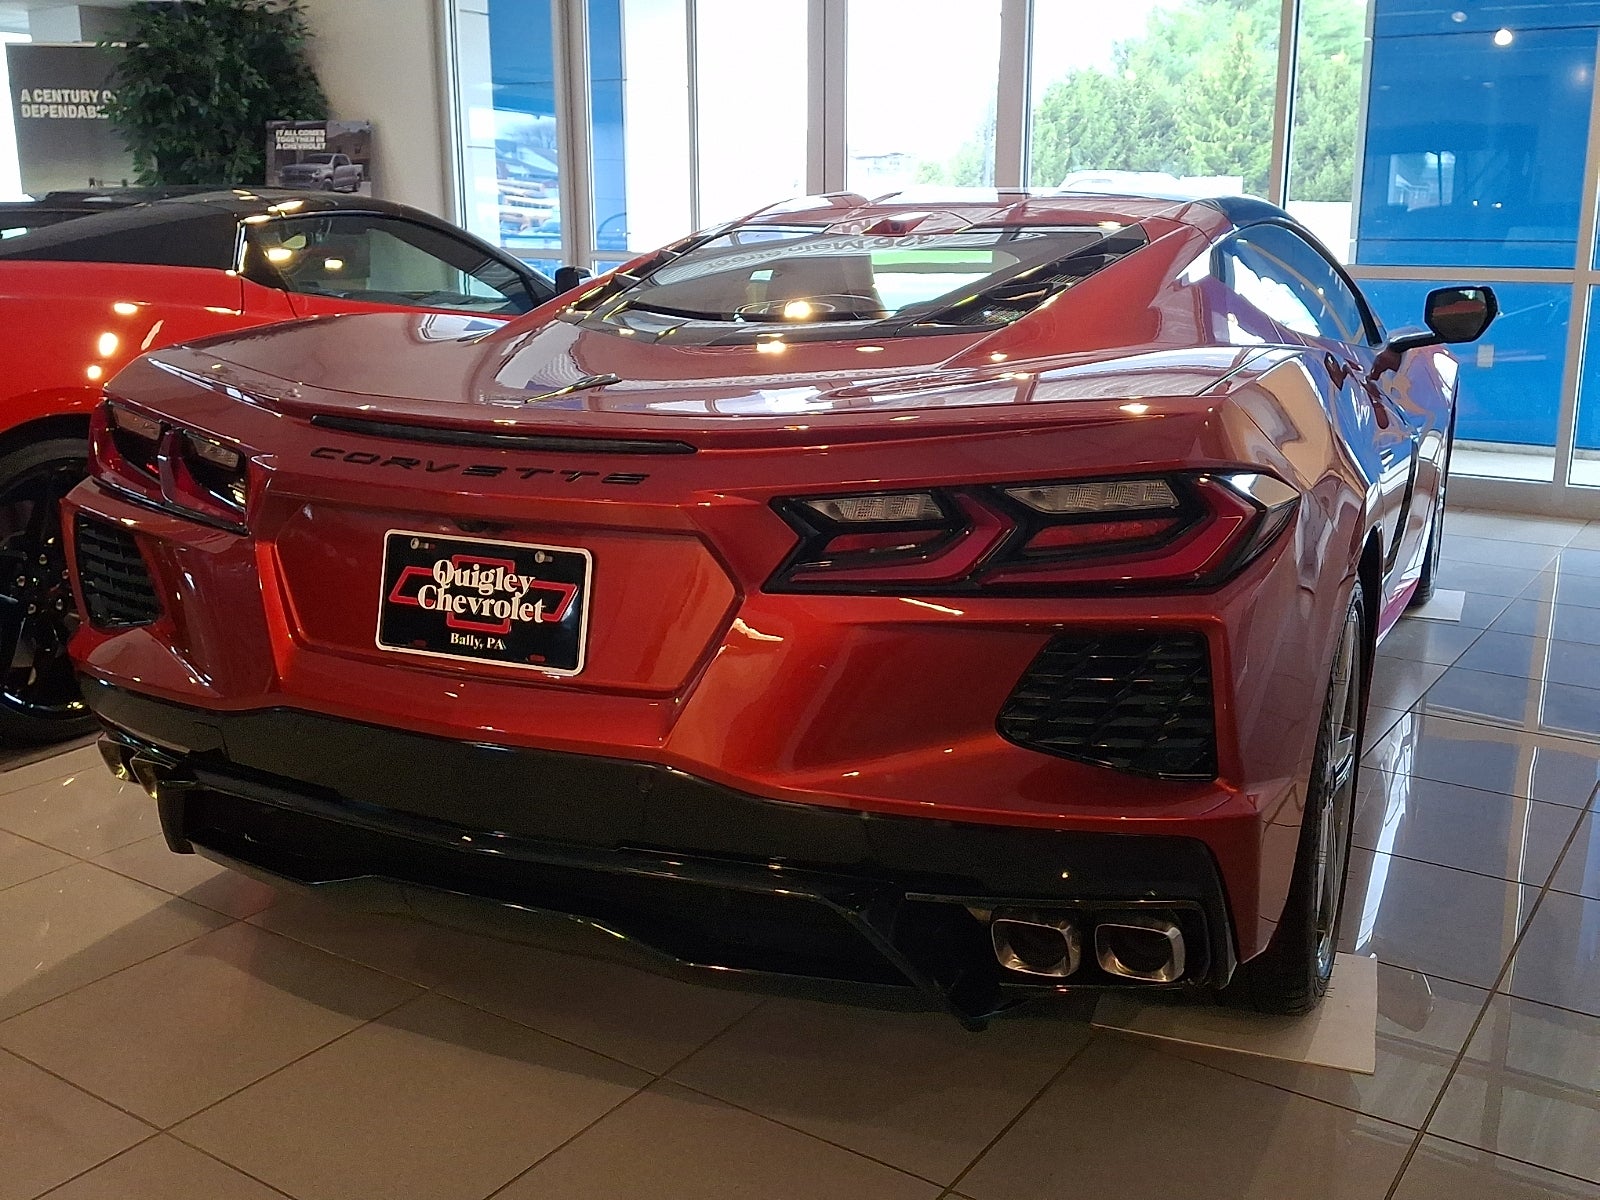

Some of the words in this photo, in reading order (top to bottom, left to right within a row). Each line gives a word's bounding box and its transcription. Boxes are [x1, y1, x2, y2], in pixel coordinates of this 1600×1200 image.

[21, 89, 31, 103] A
[33, 89, 99, 104] CENTURY
[102, 90, 116, 104] O
[310, 446, 651, 486] CORVETTE
[433, 559, 536, 597] Quigley
[418, 585, 547, 623] Chevrolet
[450, 632, 486, 650] Bally,
[487, 638, 505, 650] PA
